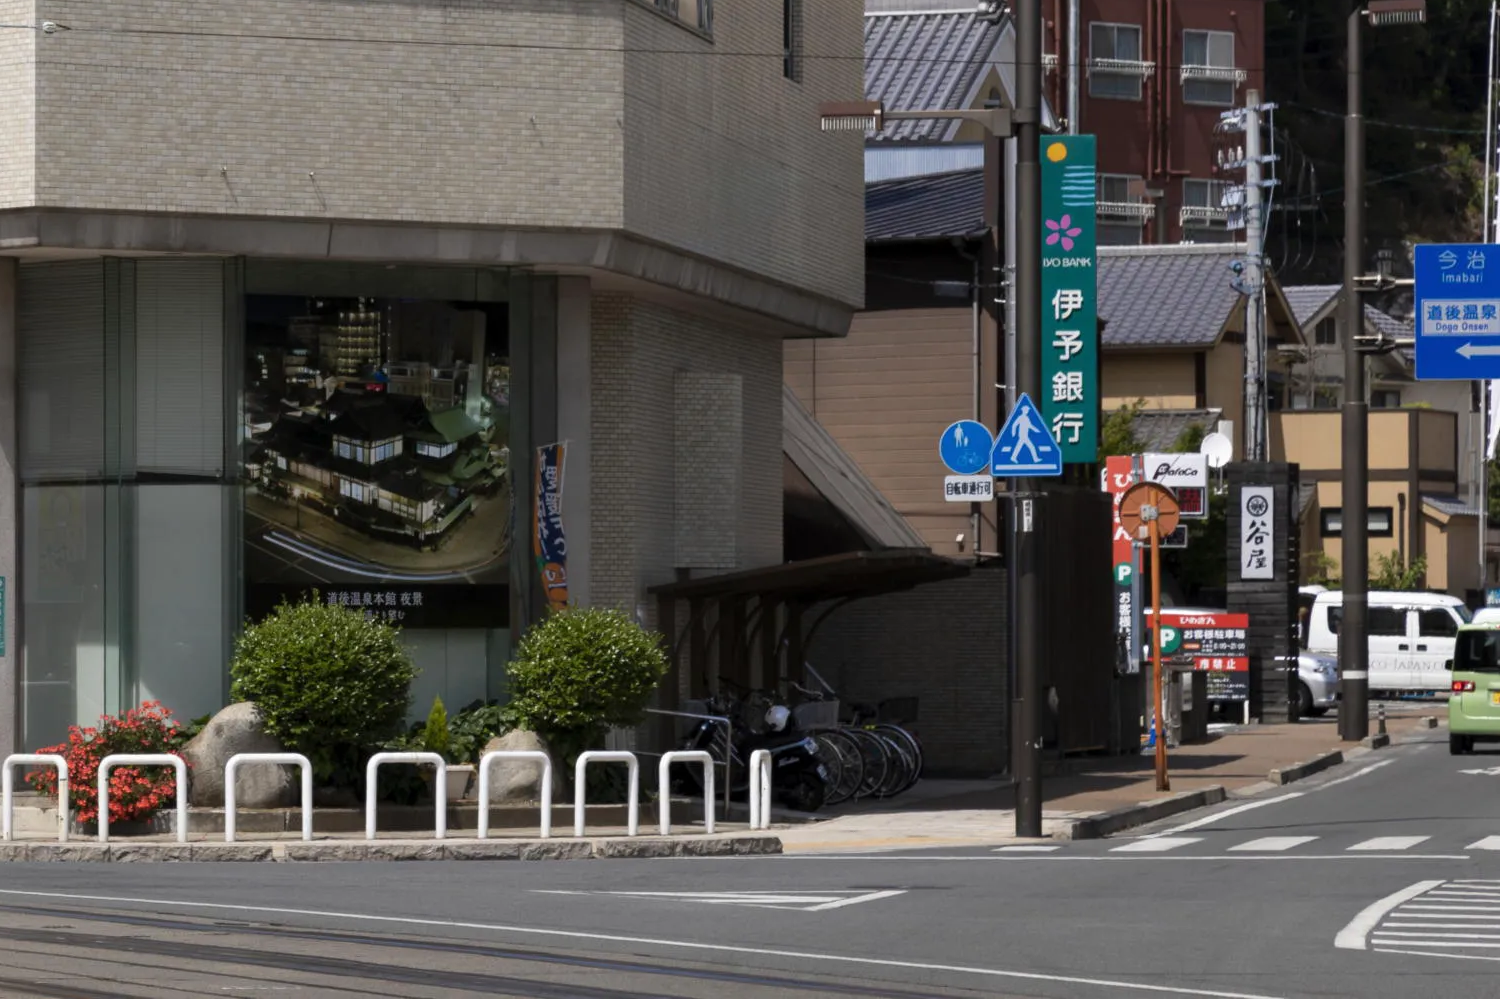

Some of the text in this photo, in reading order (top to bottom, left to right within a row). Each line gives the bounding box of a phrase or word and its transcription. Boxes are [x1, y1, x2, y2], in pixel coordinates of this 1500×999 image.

[1043, 257, 1091, 268] IYO BANK
[1438, 249, 1486, 270] 今治
[1442, 272, 1483, 283] Imabari
[1427, 304, 1497, 320] 道後温泉
[1435, 321, 1489, 333] Dogo Onsen
[1052, 289, 1084, 443] 伊予銀行
[946, 481, 991, 495] 自転車通行可
[1246, 520, 1270, 569] 谷屋
[1118, 565, 1132, 581] P
